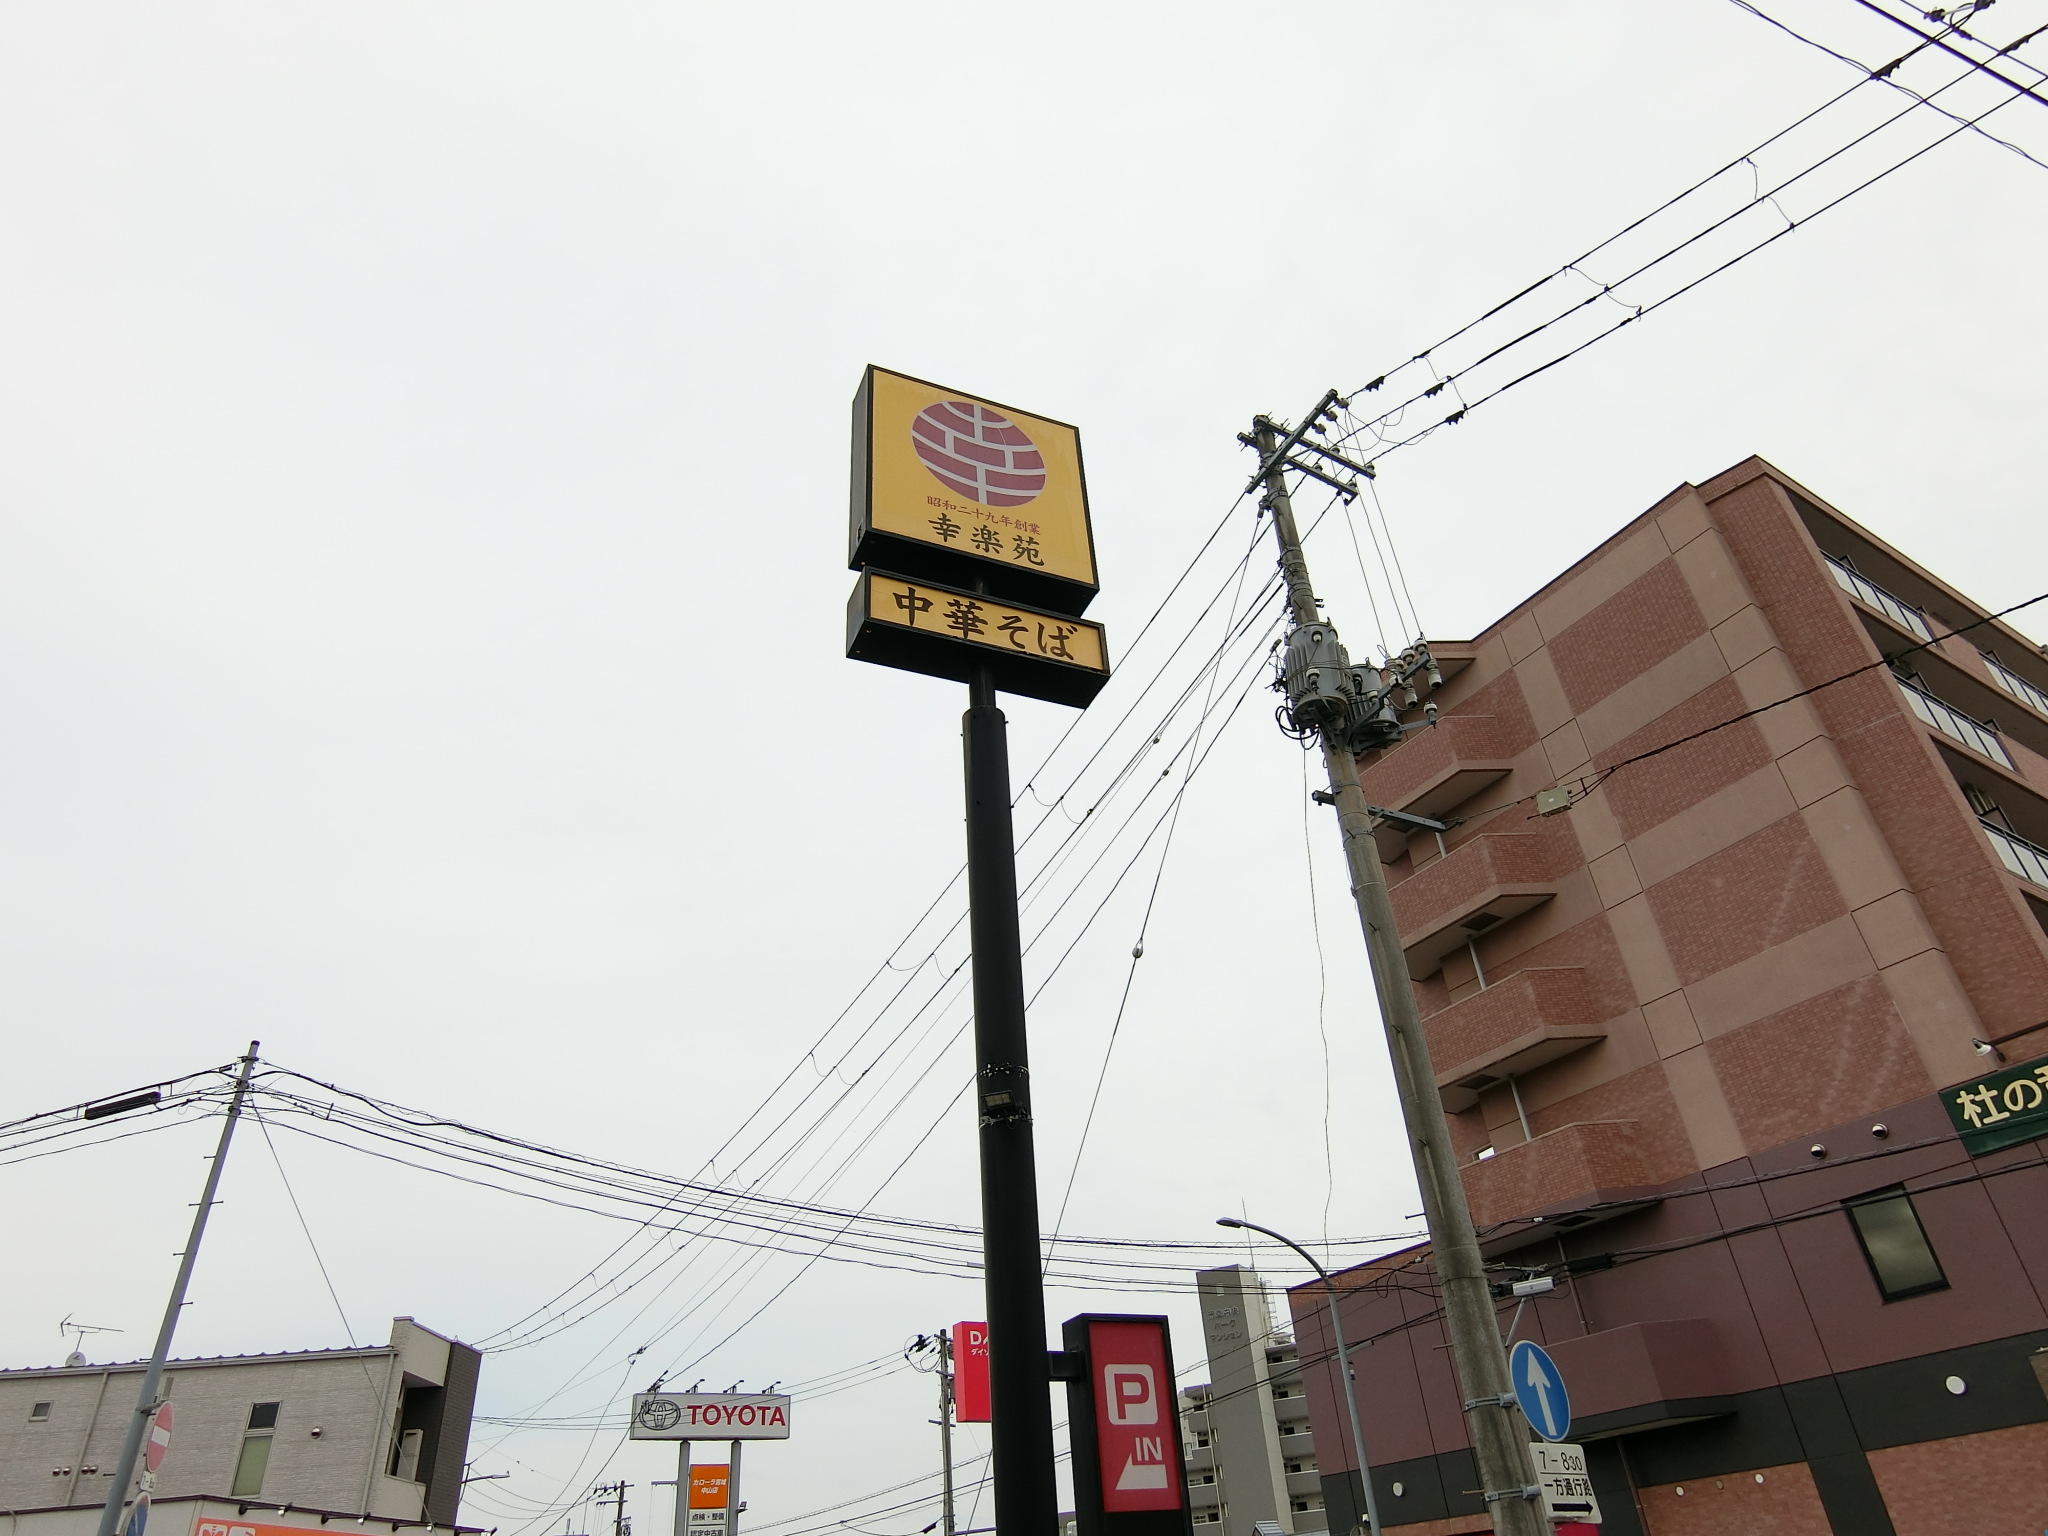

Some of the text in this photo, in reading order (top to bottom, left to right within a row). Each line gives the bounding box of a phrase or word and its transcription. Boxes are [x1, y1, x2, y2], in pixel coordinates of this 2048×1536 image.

[927, 496, 1041, 535] 昭和二十九年創業
[928, 513, 1044, 566] 幸楽苑
[893, 586, 1078, 660] 中華そば
[687, 1405, 786, 1426] TOYOTA
[1113, 1373, 1150, 1420] P
[1135, 1437, 1163, 1461] IN
